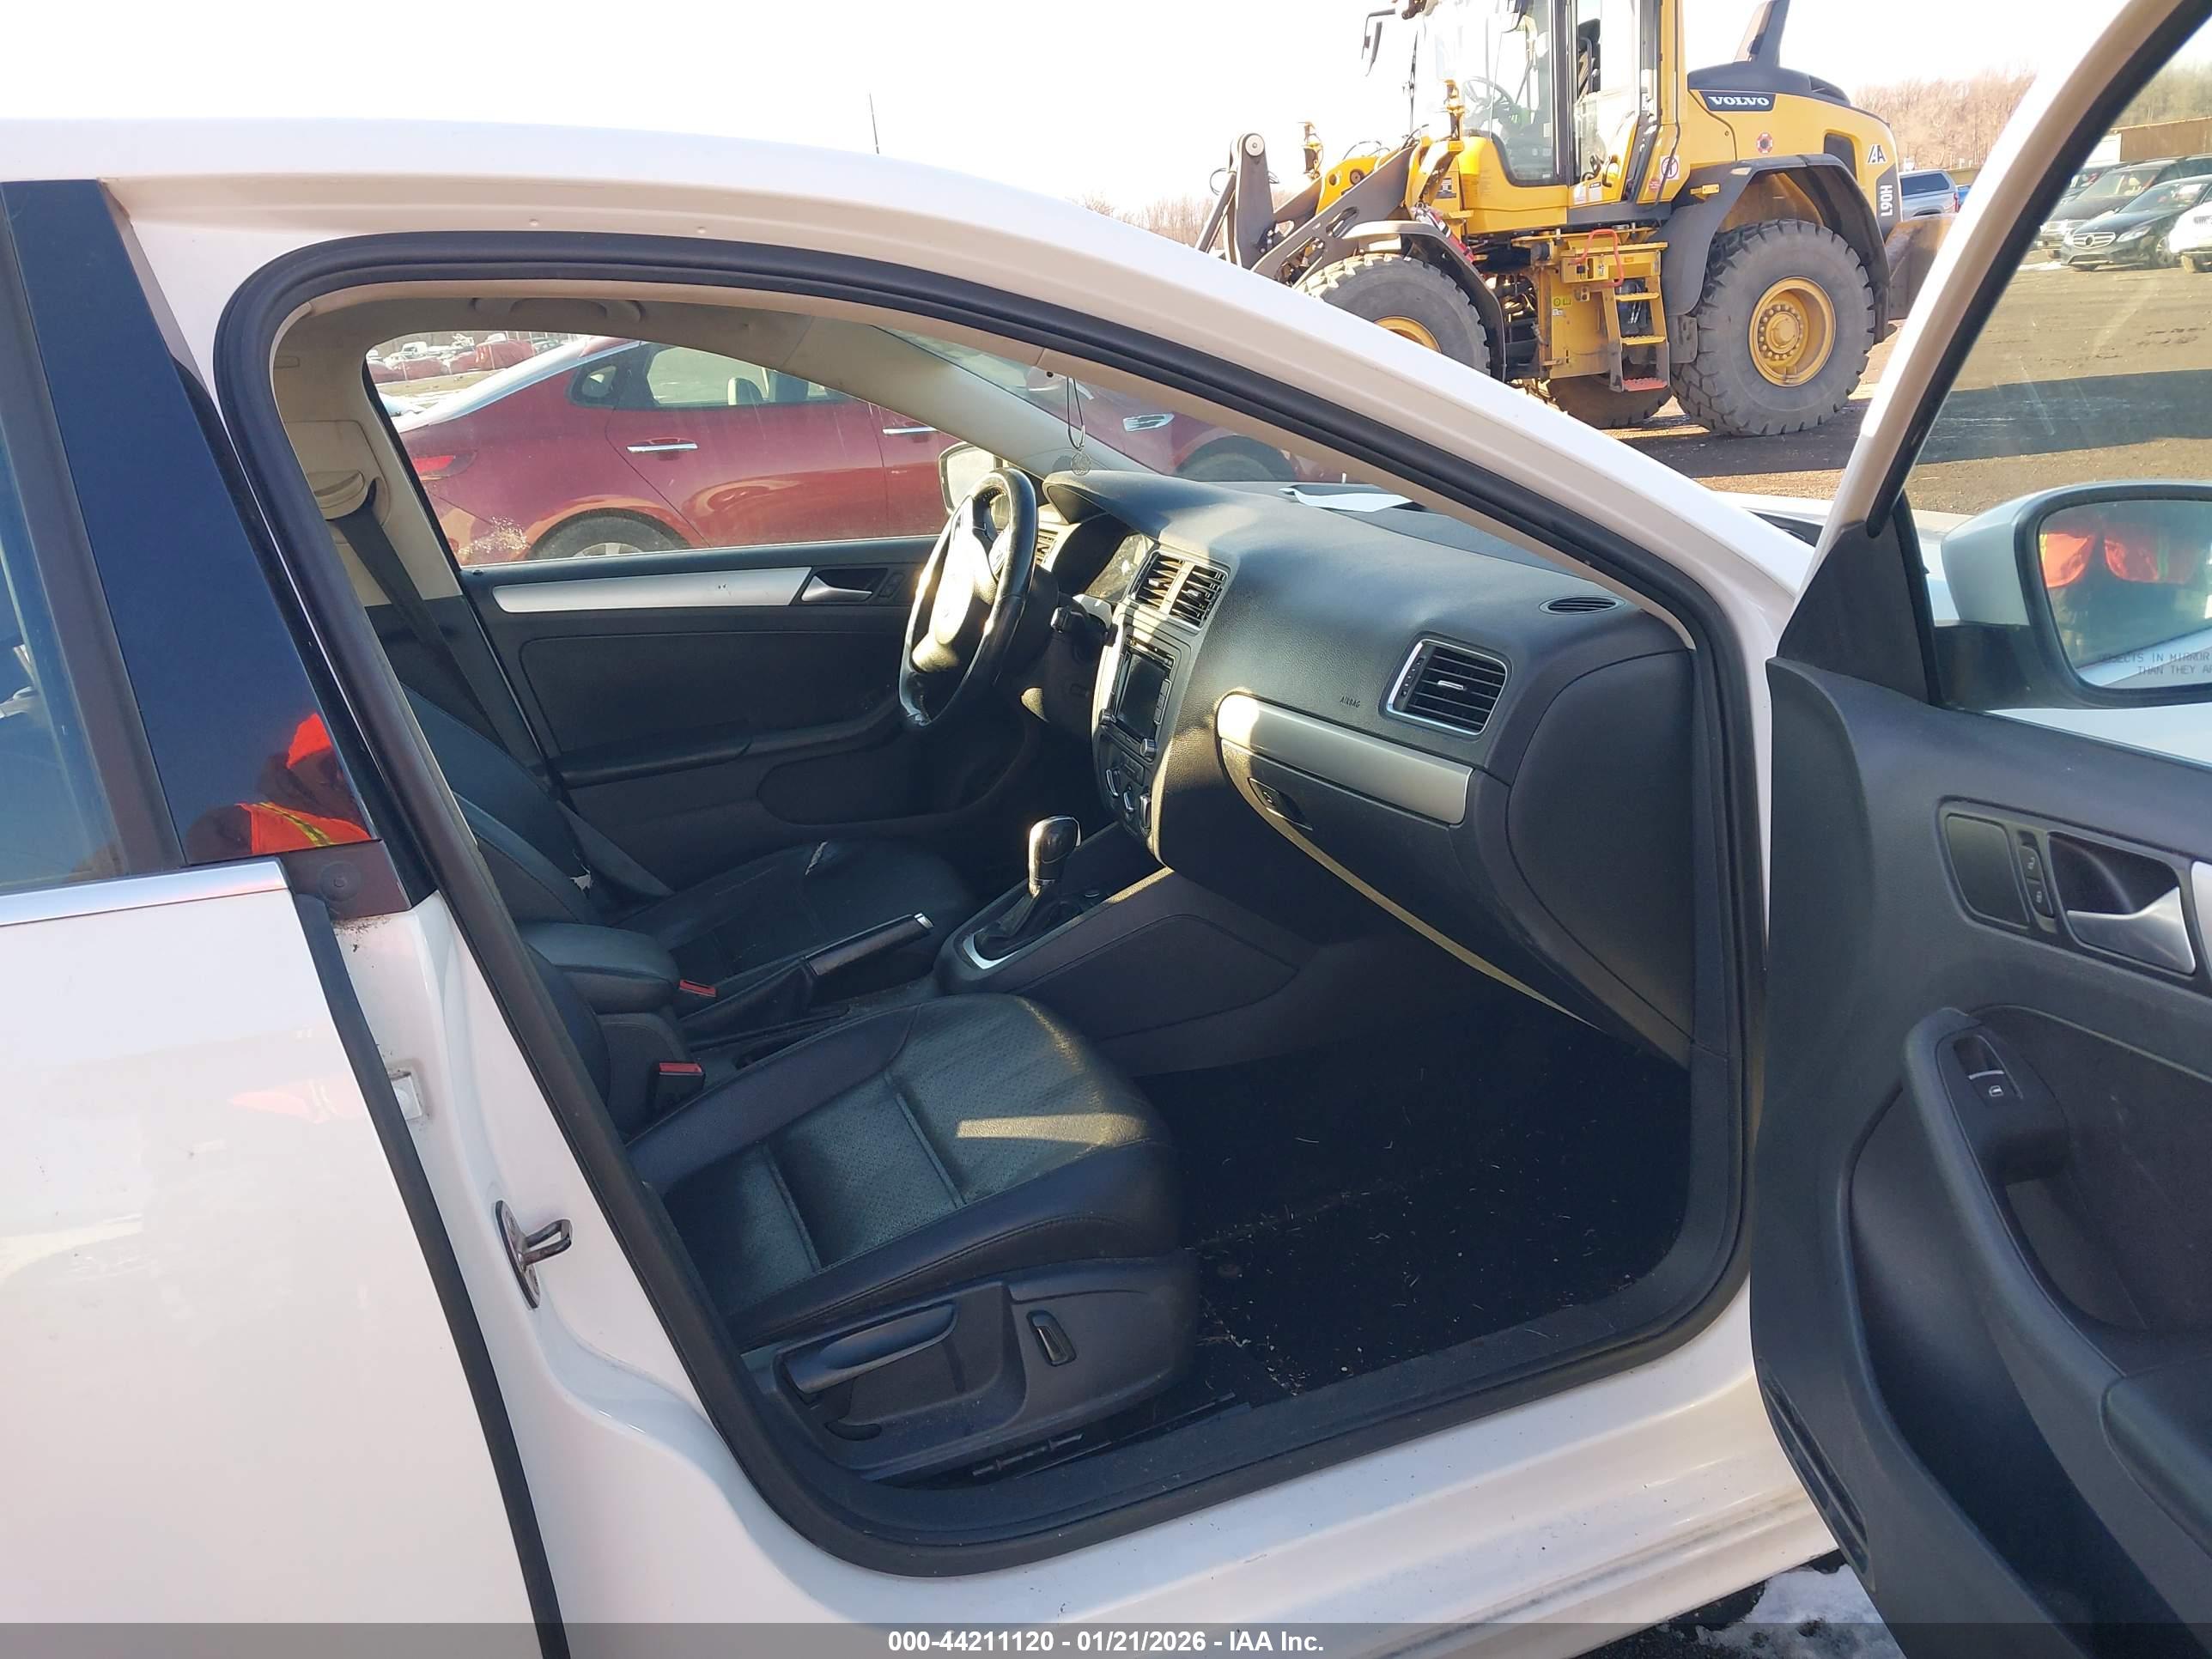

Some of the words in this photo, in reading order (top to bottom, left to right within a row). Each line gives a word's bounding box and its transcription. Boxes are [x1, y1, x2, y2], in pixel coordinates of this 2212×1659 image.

[1708, 96, 1770, 106] VOLVO
[1880, 185, 1893, 216] L90H
[2097, 653, 2144, 664] ECTS
[2152, 653, 2164, 662] IN
[2170, 652, 2210, 662] MIRROR
[2137, 665, 2164, 675] THAN
[2171, 665, 2196, 675] THEY
[1340, 696, 1361, 708] AIRBAG
